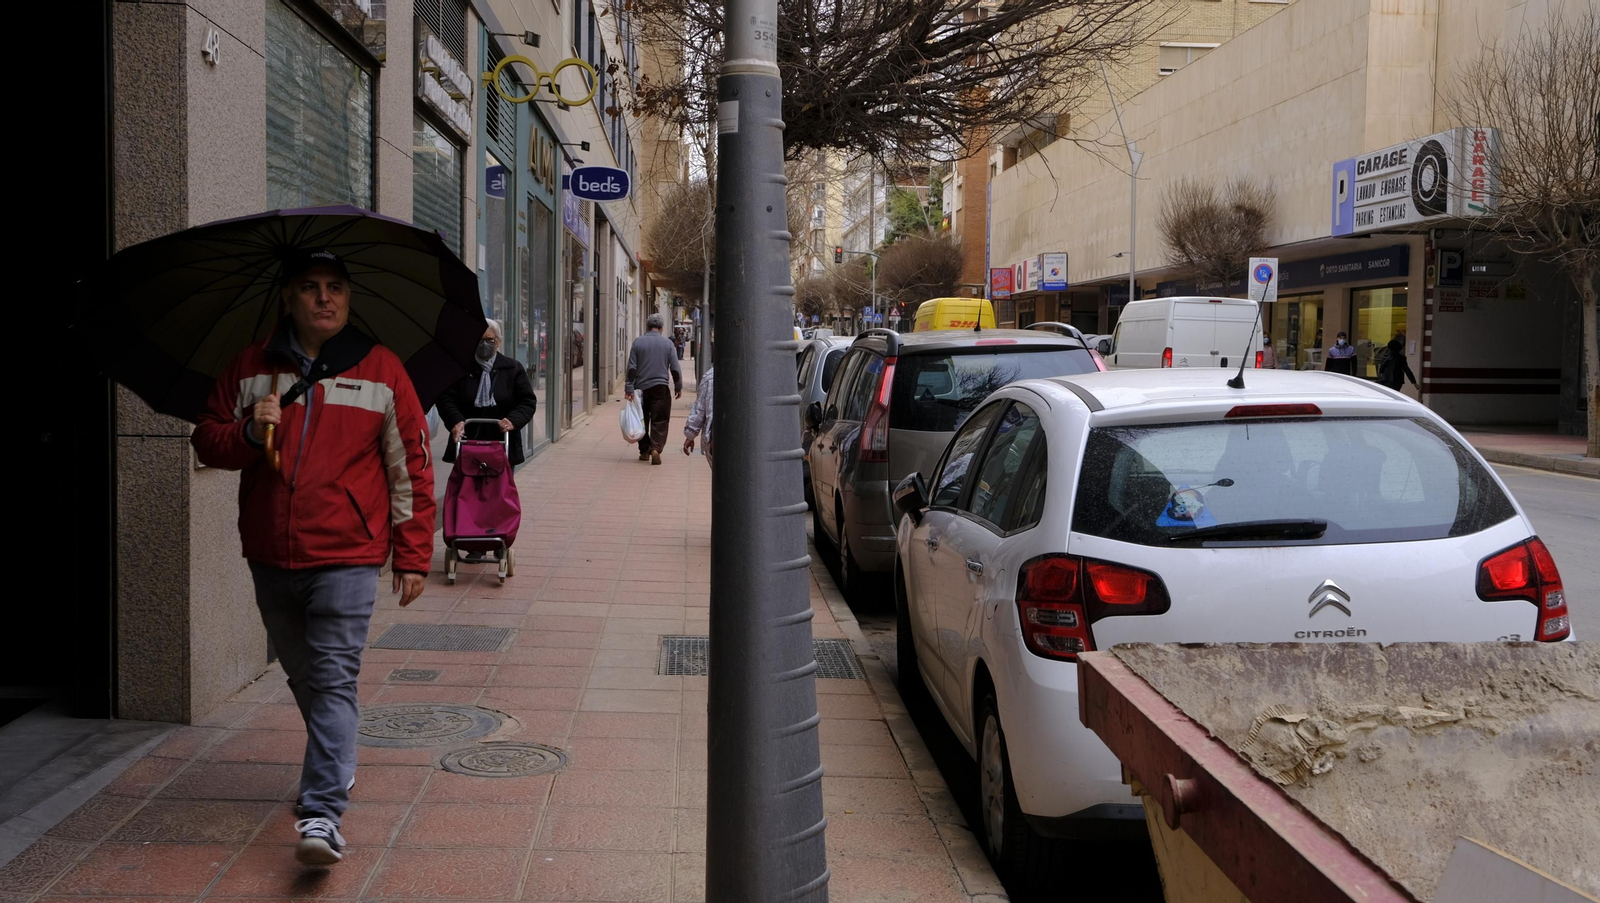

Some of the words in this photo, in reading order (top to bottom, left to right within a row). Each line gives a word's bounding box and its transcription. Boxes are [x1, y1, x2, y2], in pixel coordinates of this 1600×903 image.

[204, 27, 219, 65] 48
[1356, 148, 1408, 176] GARAGE
[1471, 130, 1487, 202] GARAGE
[578, 174, 621, 193] bed's
[1356, 183, 1376, 202] LAVADO
[1380, 175, 1407, 197] ENGRASE
[1355, 209, 1374, 227] PARKING
[1379, 203, 1407, 223] ESTANCIAS
[1325, 264, 1338, 274] ORTO
[1338, 262, 1363, 273] SANITARIA
[1367, 258, 1391, 269] SANICOR
